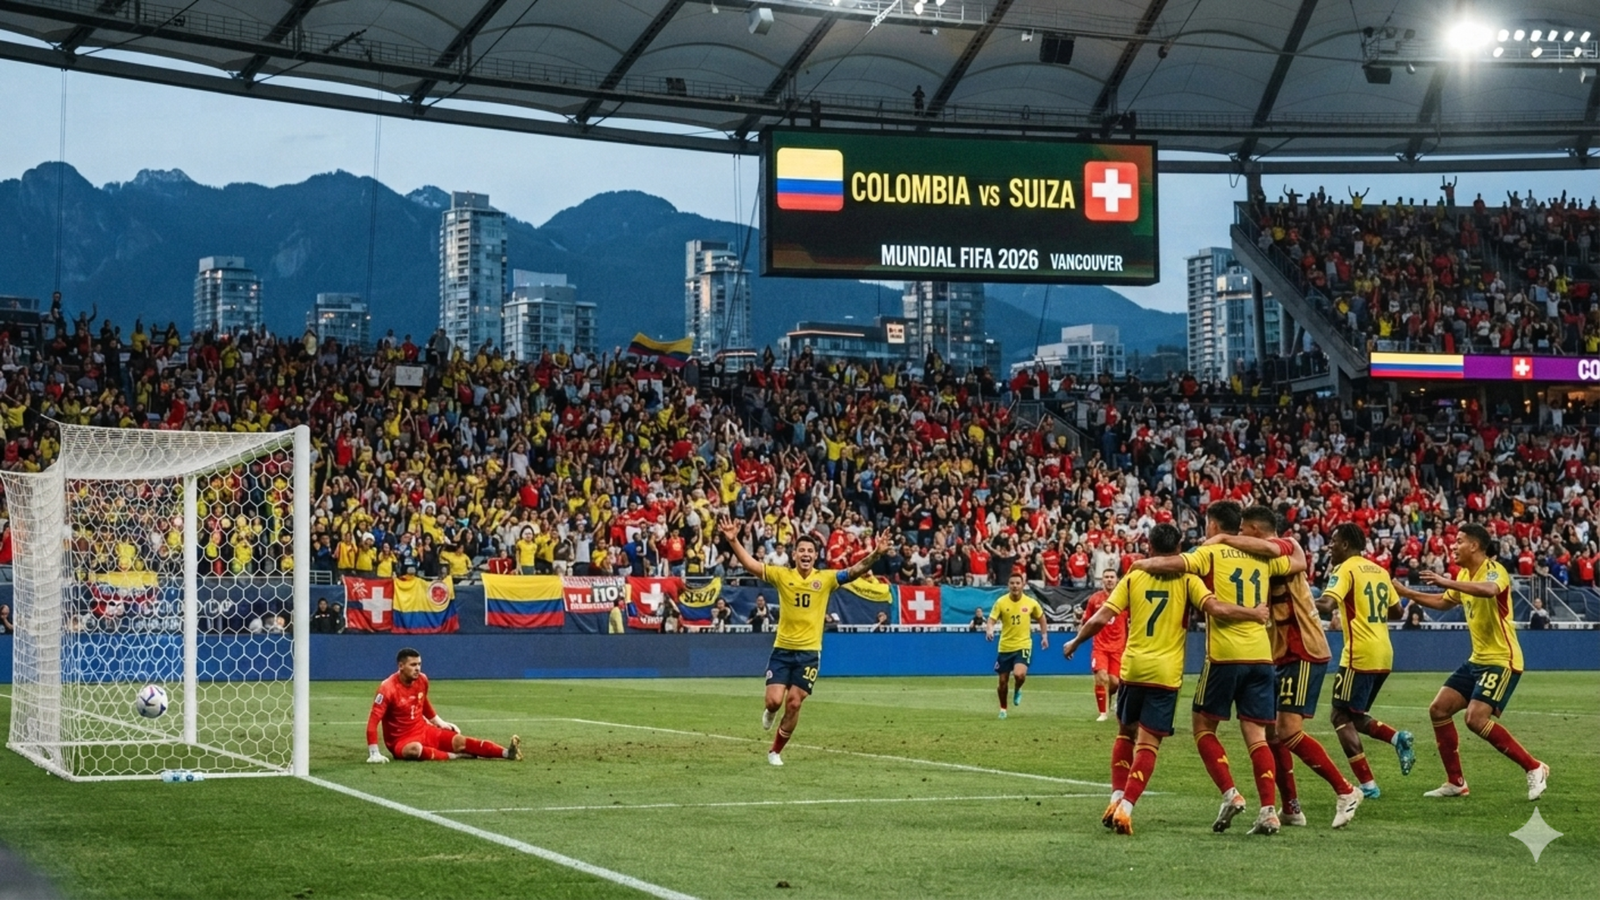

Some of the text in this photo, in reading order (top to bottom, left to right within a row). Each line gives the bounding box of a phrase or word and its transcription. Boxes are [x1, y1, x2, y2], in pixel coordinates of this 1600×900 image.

[851, 171, 971, 205] COLOMBIA
[1009, 178, 1075, 209] SUIZA
[881, 244, 1123, 271] MUNDIAL FIFA 2026 VANCOUVER
[1578, 358, 1600, 381] CO
[1229, 567, 1261, 607] 11
[1145, 590, 1169, 637] 7
[1363, 581, 1389, 624] 18
[802, 666, 819, 682] 10
[1280, 677, 1294, 696] 11
[1476, 671, 1498, 690] 18
